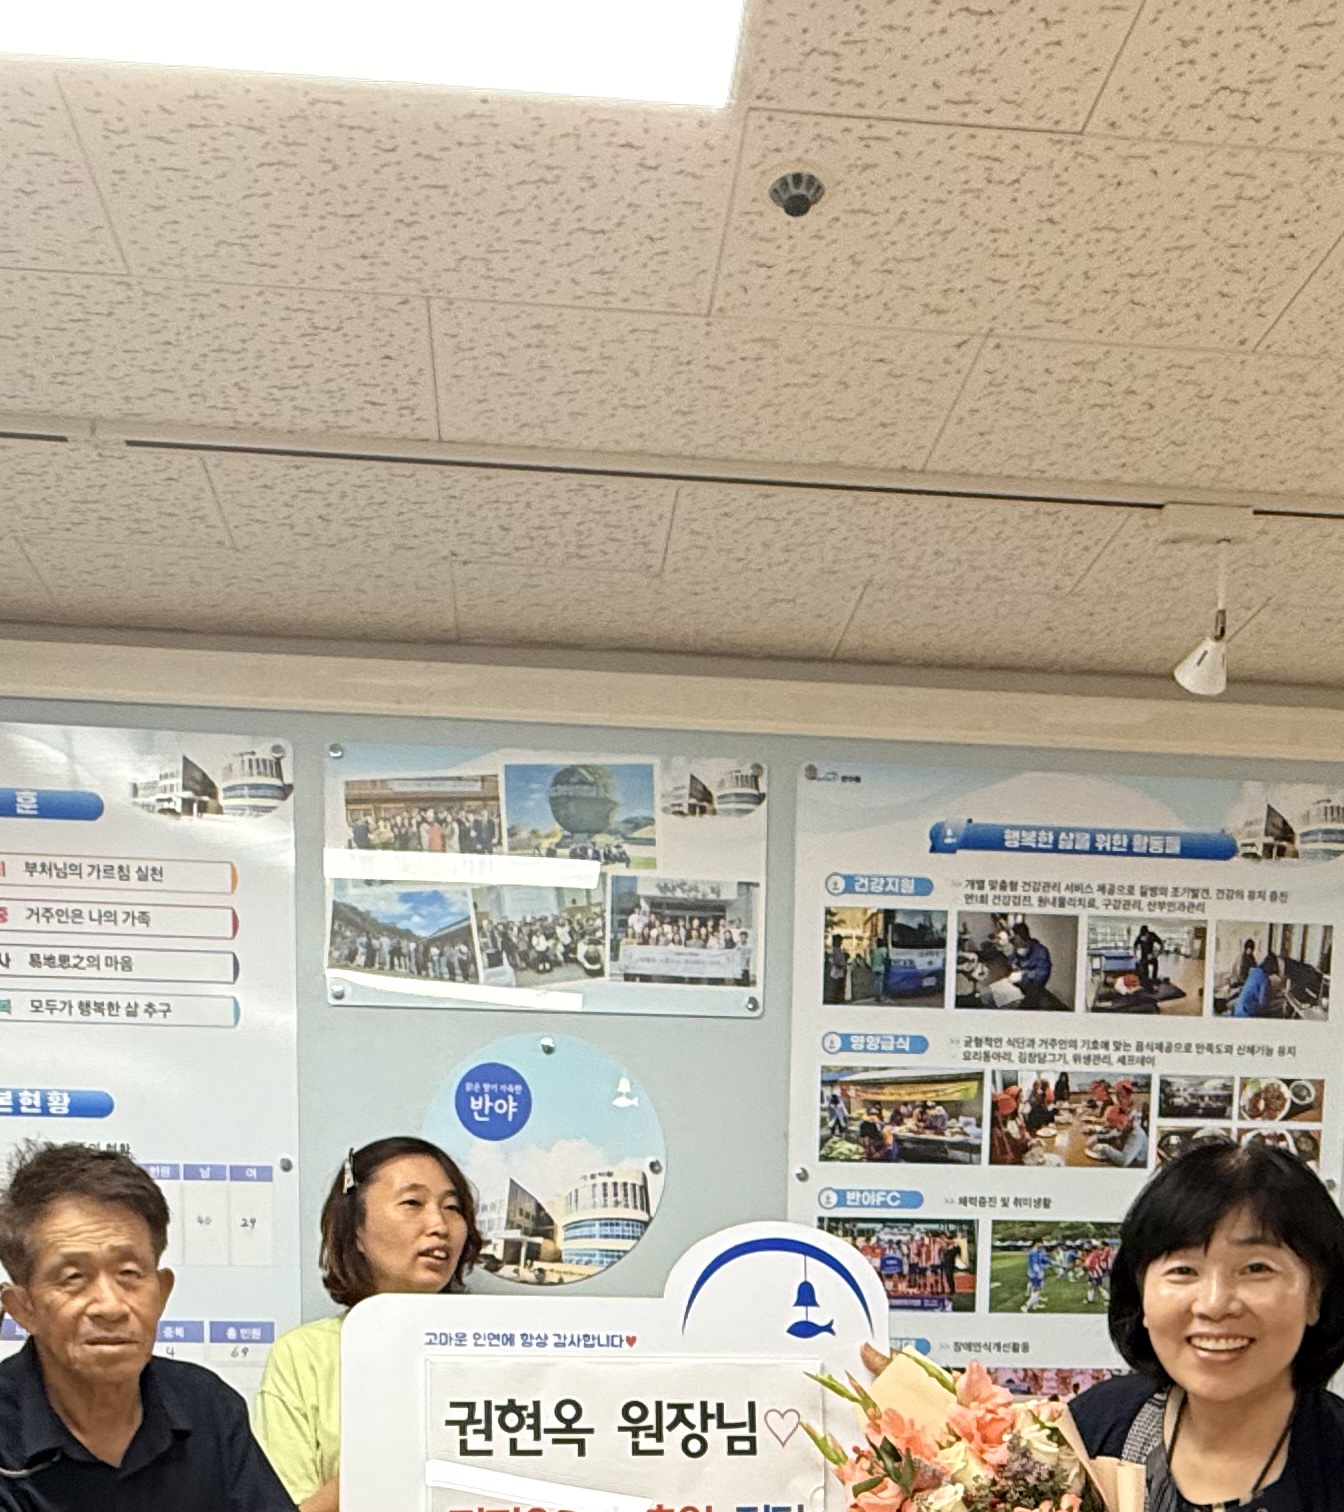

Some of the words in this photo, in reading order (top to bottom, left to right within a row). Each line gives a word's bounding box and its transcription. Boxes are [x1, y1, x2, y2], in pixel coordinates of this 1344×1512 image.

[1003, 828, 1054, 849] 행복한
[1058, 831, 1091, 850] 삶을
[1095, 833, 1128, 852] 위한
[24, 861, 82, 878] 부처님의
[87, 864, 130, 881] 가르침
[136, 867, 164, 882] 실천
[854, 877, 915, 893] 건강지원
[1021, 882, 1061, 894] 건강관리
[1064, 883, 1094, 895] 서비스
[1097, 884, 1135, 897] 제공으로
[26, 907, 84, 924] 거주인은
[89, 909, 118, 925] 나의
[122, 911, 150, 927] 가족
[104, 954, 133, 971] 마음
[30, 998, 73, 1014] 모두가
[78, 1000, 120, 1017] 행복한
[144, 1003, 172, 1019] 추구
[850, 1035, 910, 1051] 영양급식
[1006, 1037, 1035, 1049] 식단과
[1038, 1038, 1078, 1051] 거주인의
[470, 1095, 518, 1121] 반야
[246, 1168, 257, 1178] 여
[845, 1191, 901, 1206] 반야FC
[1001, 1197, 1010, 1207] 및
[1013, 1198, 1052, 1209] 취미생활
[424, 1333, 468, 1348] 고마운
[473, 1333, 516, 1348] 인연에
[520, 1333, 549, 1349] 항상
[444, 1398, 595, 1458] 권현옥
[617, 1400, 758, 1457] 원장님
